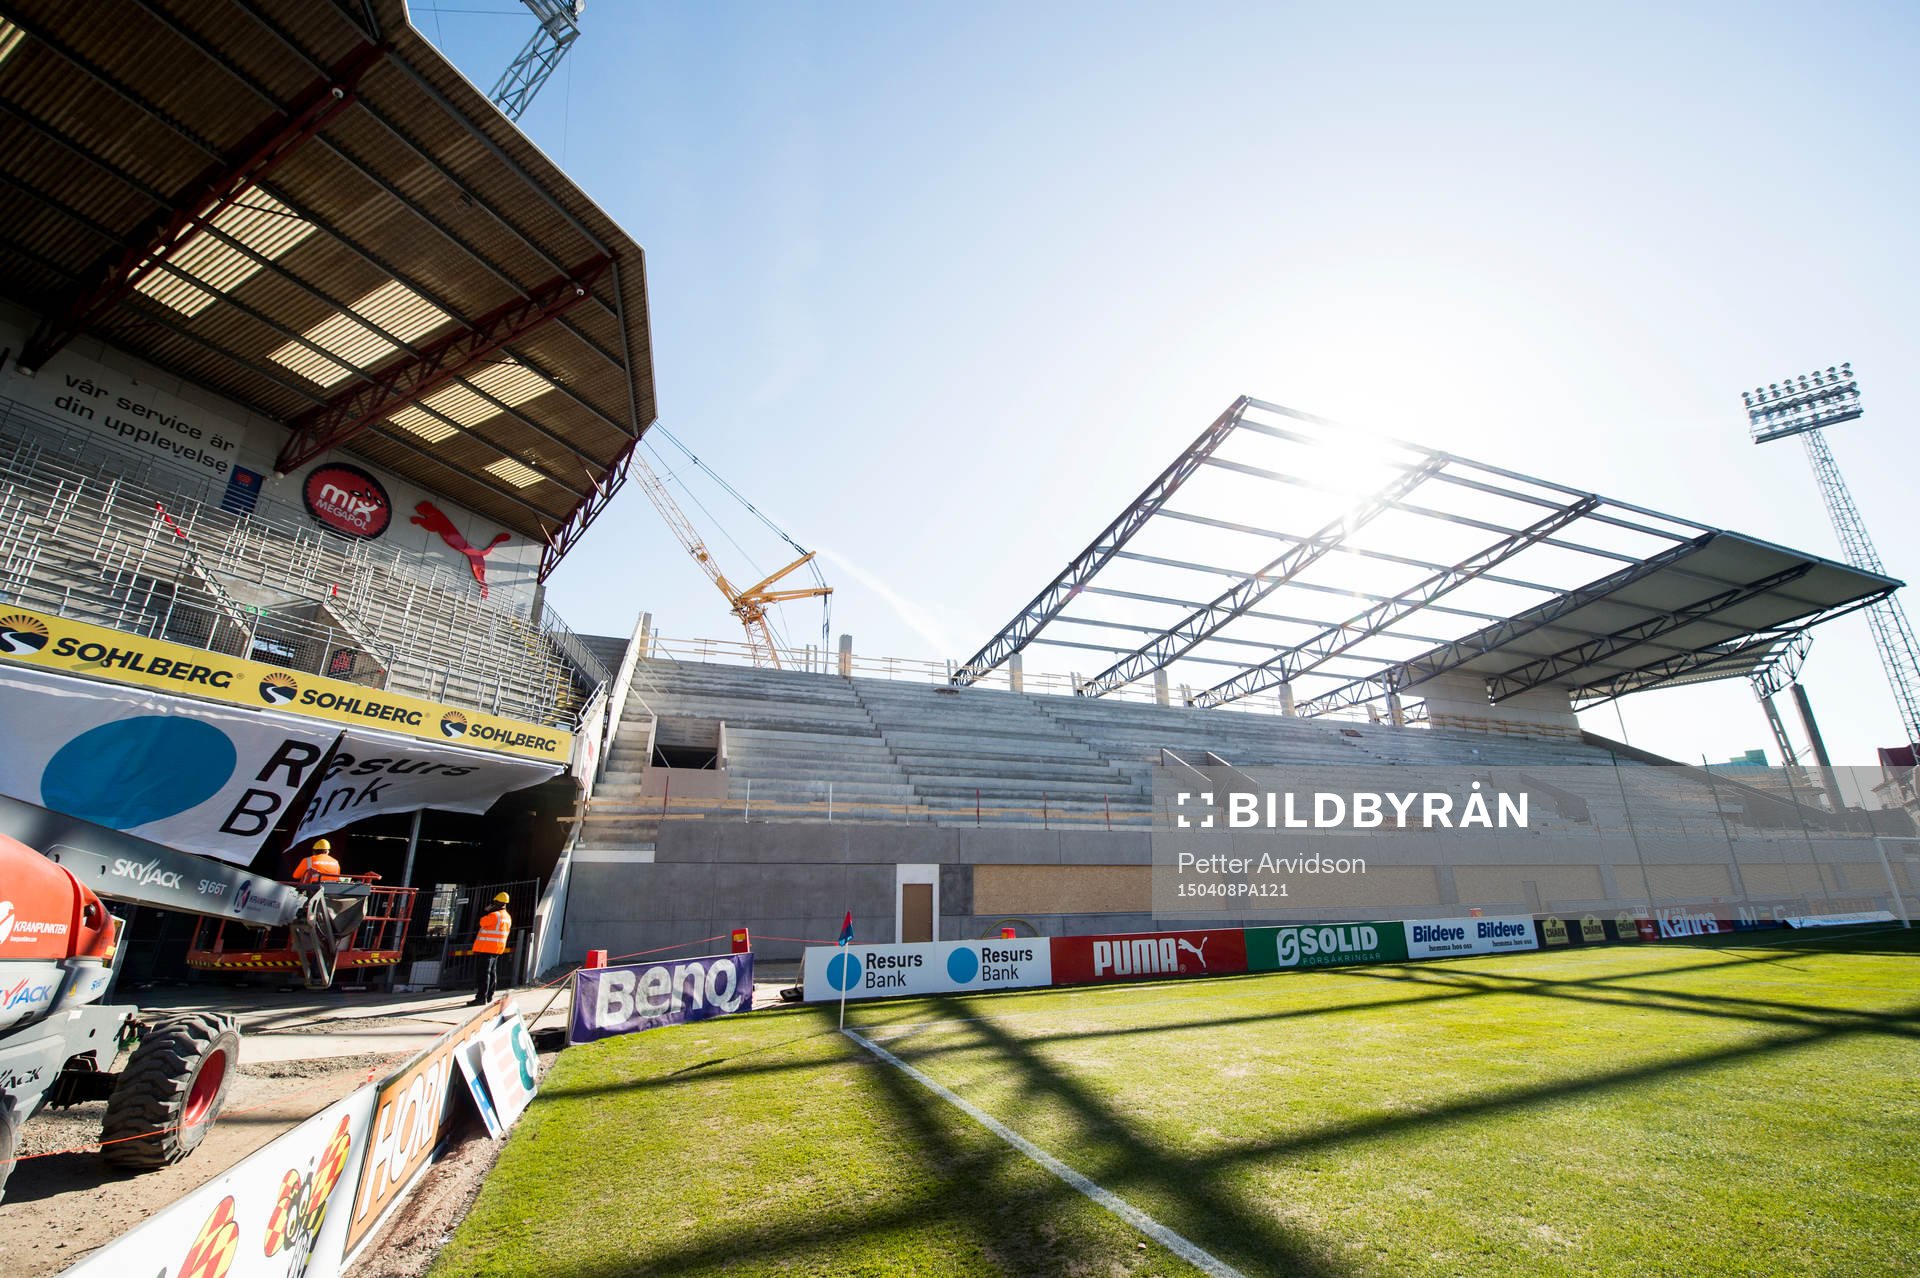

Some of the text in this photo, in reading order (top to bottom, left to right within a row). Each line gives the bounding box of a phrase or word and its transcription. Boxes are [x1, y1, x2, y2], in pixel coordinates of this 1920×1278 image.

[65, 374, 235, 452] vår service är
[54, 394, 229, 474] din upplevelse
[315, 499, 368, 531] MEGAPOL
[319, 483, 377, 522] mix
[51, 636, 233, 690] SOHLBERG
[300, 687, 424, 728] SOHLBERG
[469, 722, 557, 753] SOHLBERG
[112, 858, 183, 889] SKYJACK
[13, 920, 68, 935] KRANPUNKTEN
[1412, 924, 1465, 943] Bildeve
[1477, 921, 1525, 939] Bildeve
[1655, 907, 1720, 938] Kährs
[981, 946, 1033, 964] Resurs
[1300, 926, 1378, 955] SOLID
[865, 952, 923, 970] Resurs
[1093, 937, 1178, 976] PUMA
[865, 971, 907, 989] Bank
[982, 964, 1019, 982] Bank
[0, 978, 52, 1010] YJACK
